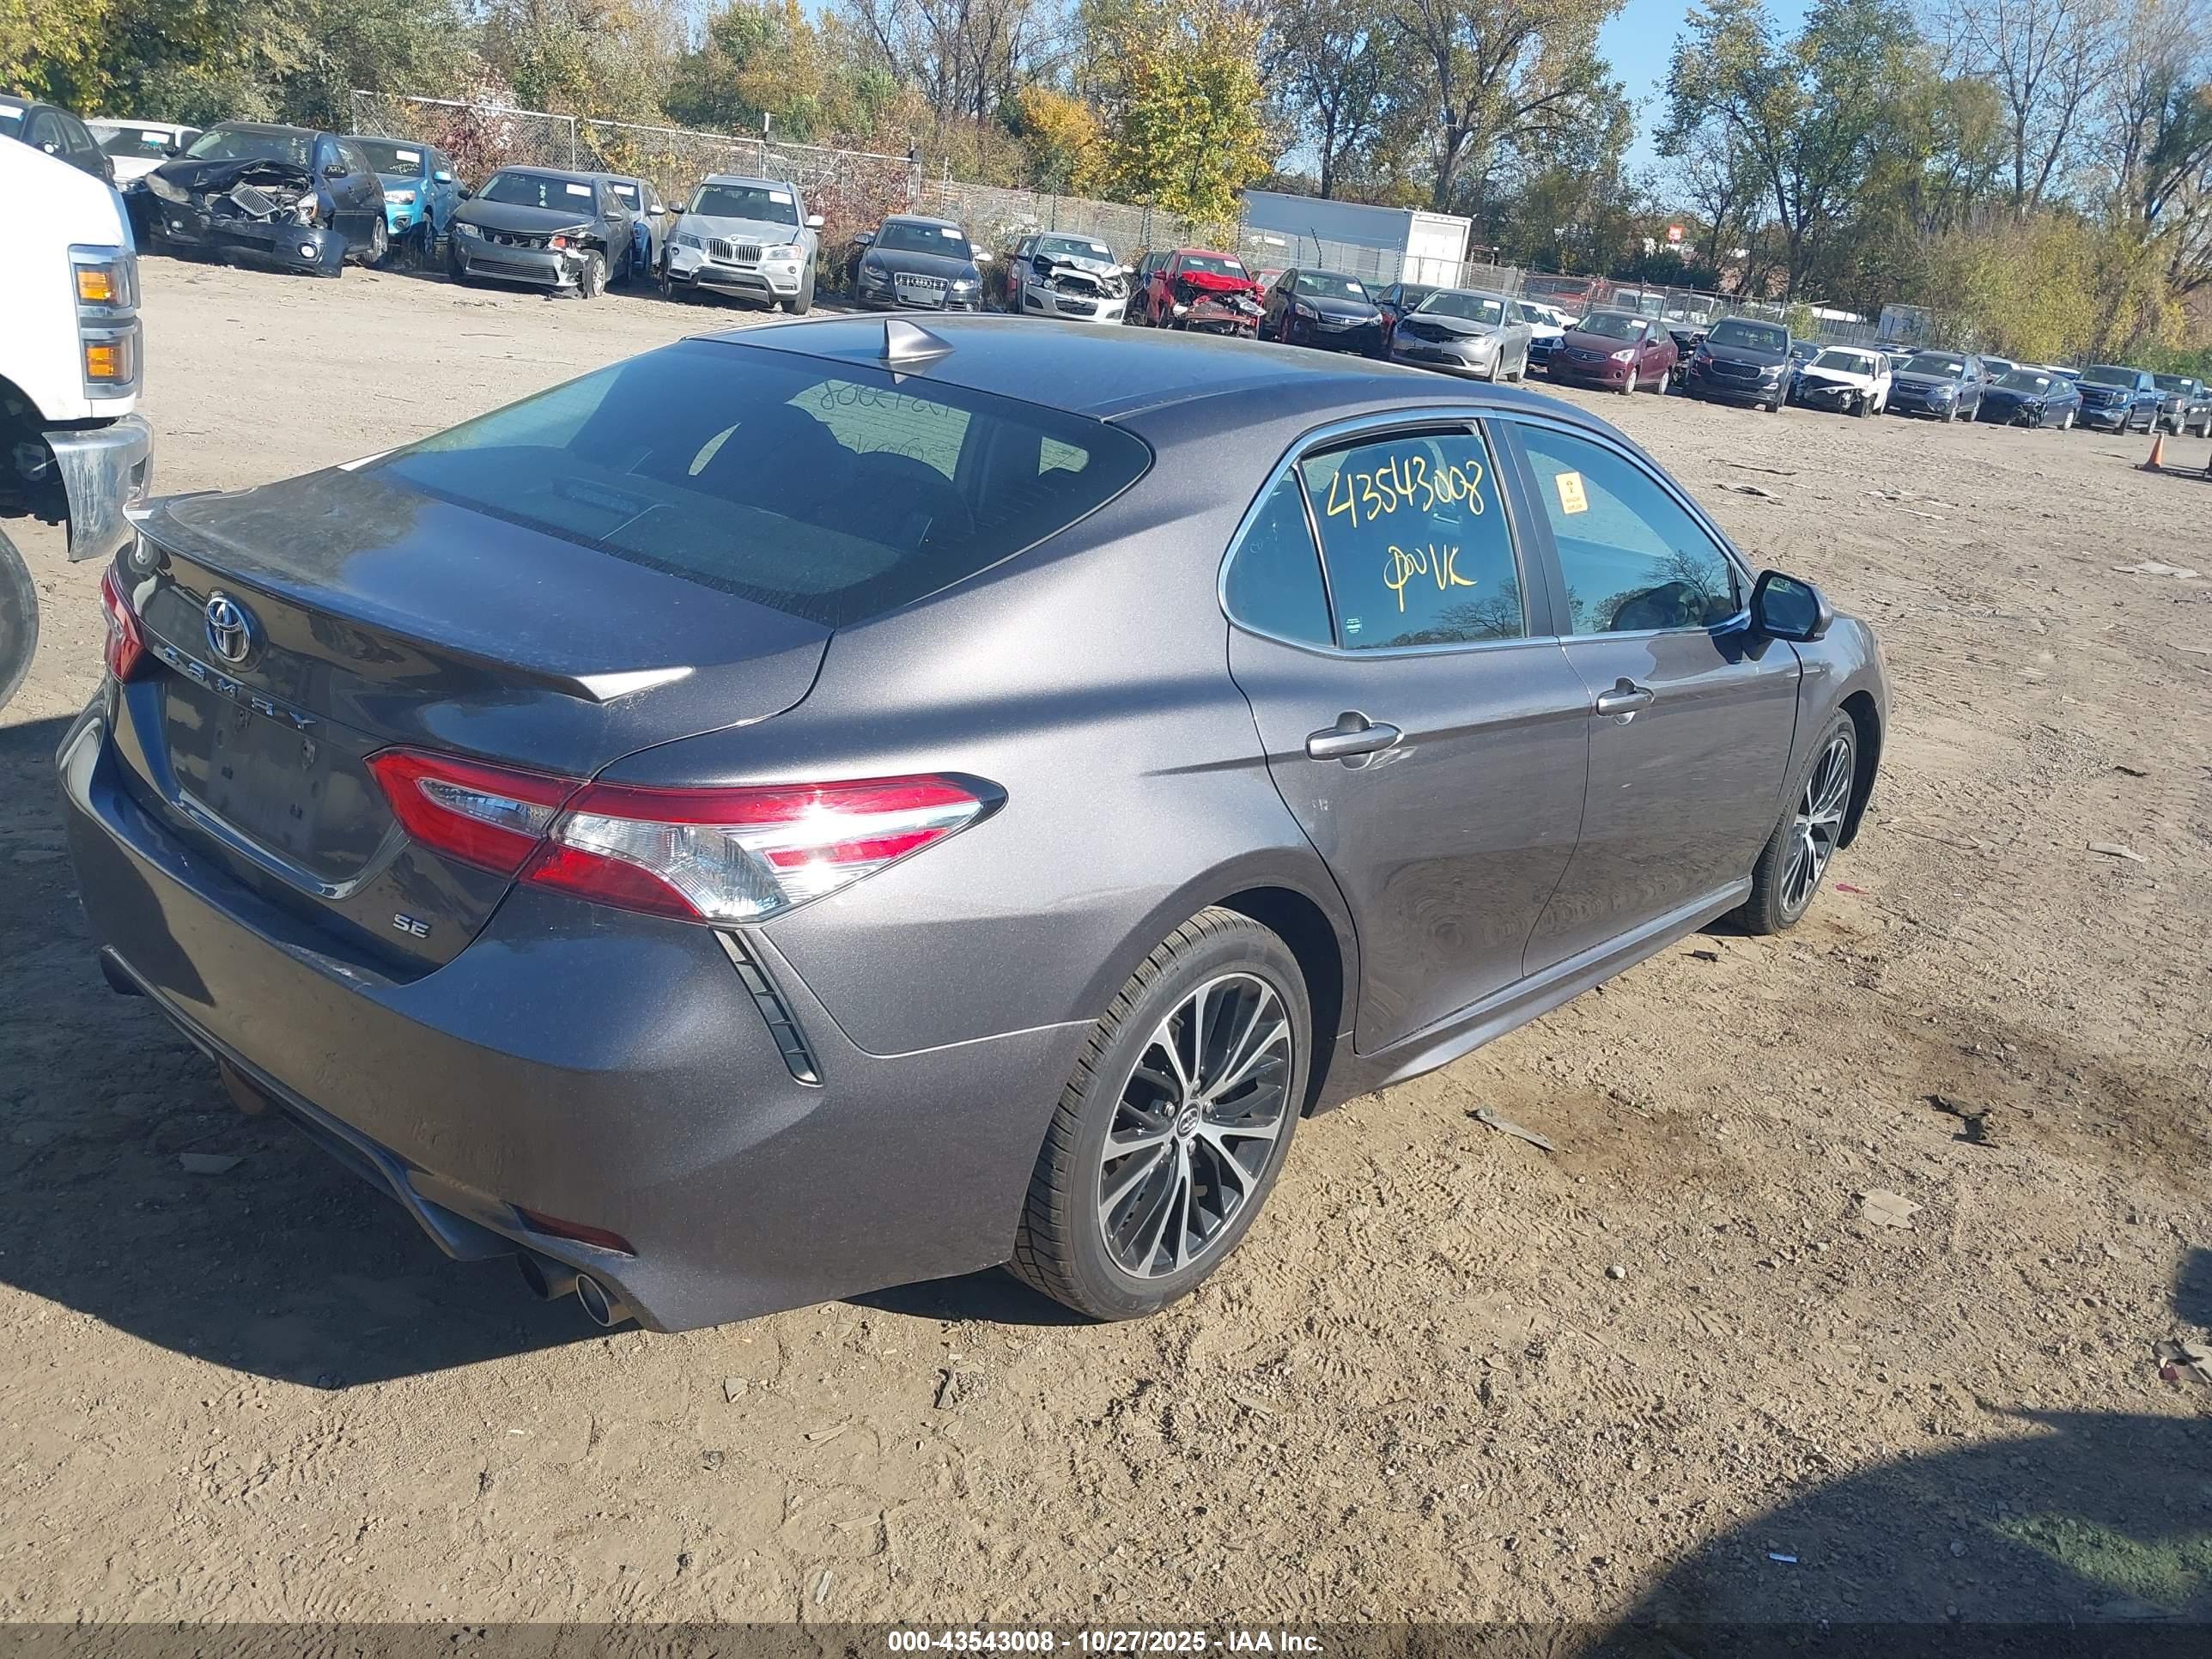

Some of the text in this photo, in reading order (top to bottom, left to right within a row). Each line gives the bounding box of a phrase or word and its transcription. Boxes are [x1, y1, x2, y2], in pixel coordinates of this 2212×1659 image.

[1327, 455, 1485, 529] 43543008
[163, 646, 317, 730] CAMRY
[392, 914, 430, 939] SE
